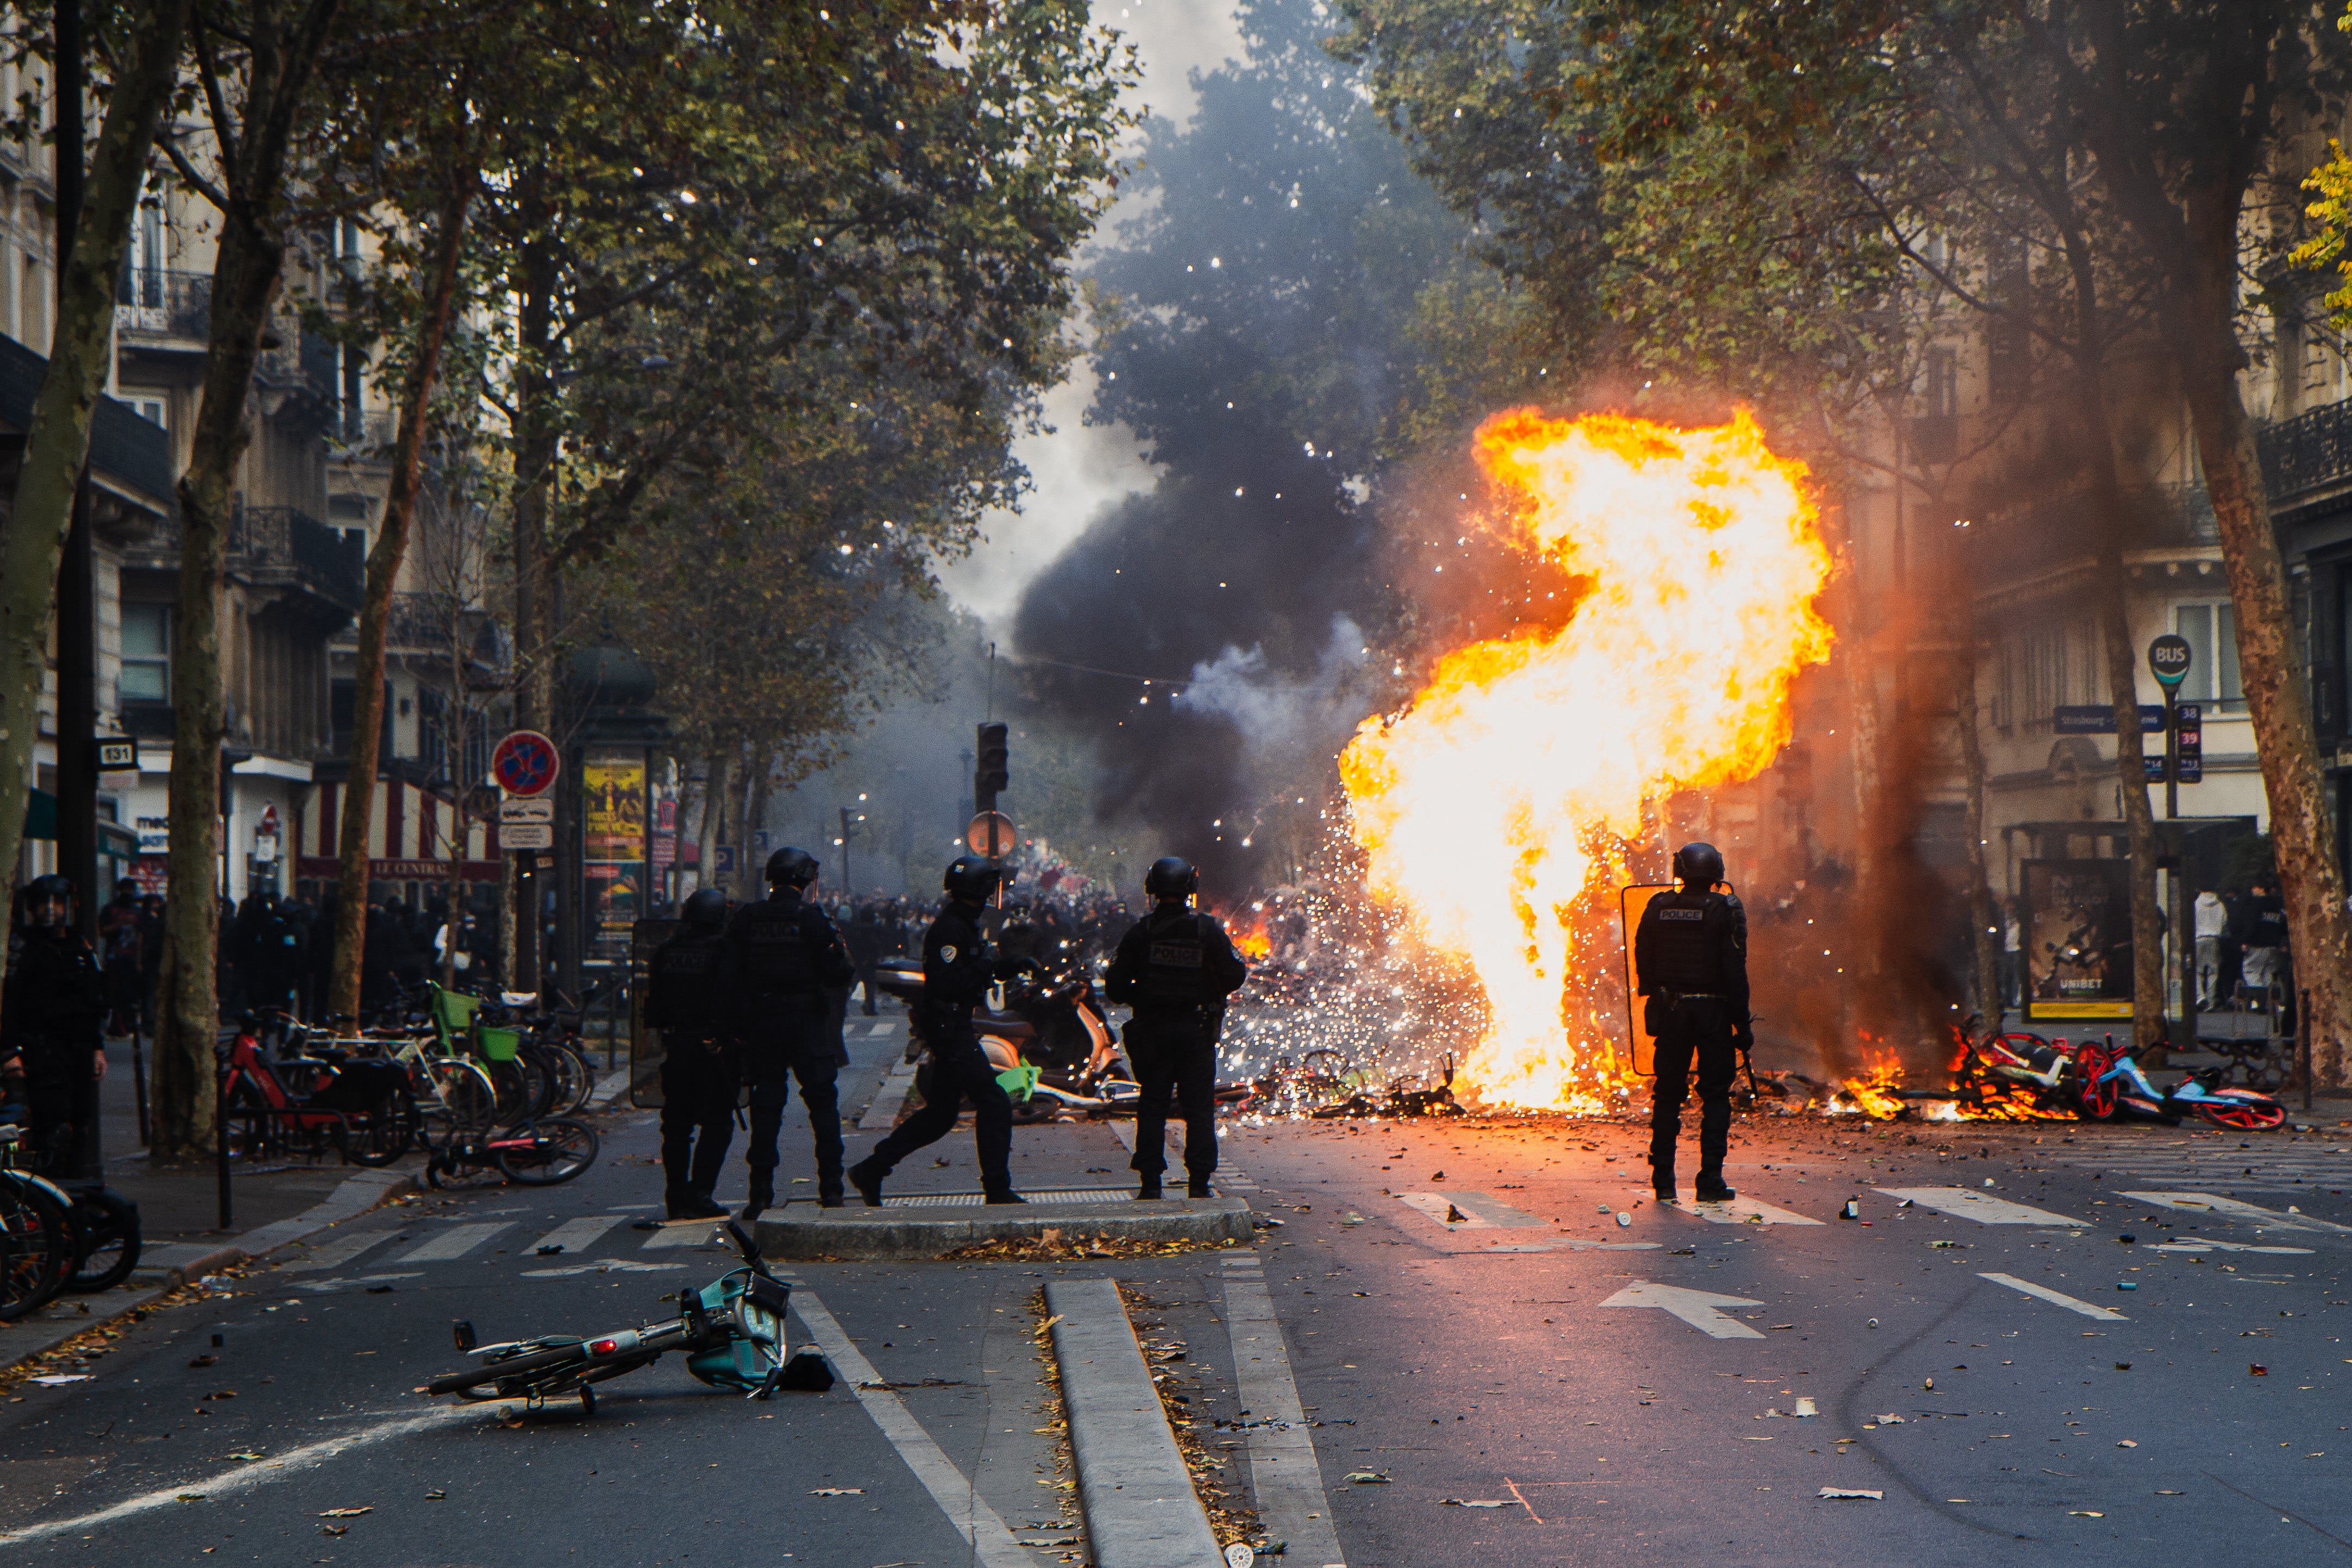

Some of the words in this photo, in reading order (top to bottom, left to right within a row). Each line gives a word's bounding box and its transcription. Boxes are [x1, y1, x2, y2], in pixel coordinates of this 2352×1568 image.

[2155, 647, 2186, 663] BUS
[2182, 707, 2197, 719] 38
[2061, 715, 2105, 727] Strasbourg
[2181, 733, 2197, 744] 39
[105, 747, 128, 761] 131
[1662, 910, 1700, 919] POLICE
[1153, 946, 1199, 961] POLICE
[2060, 979, 2103, 989] UNIBET
